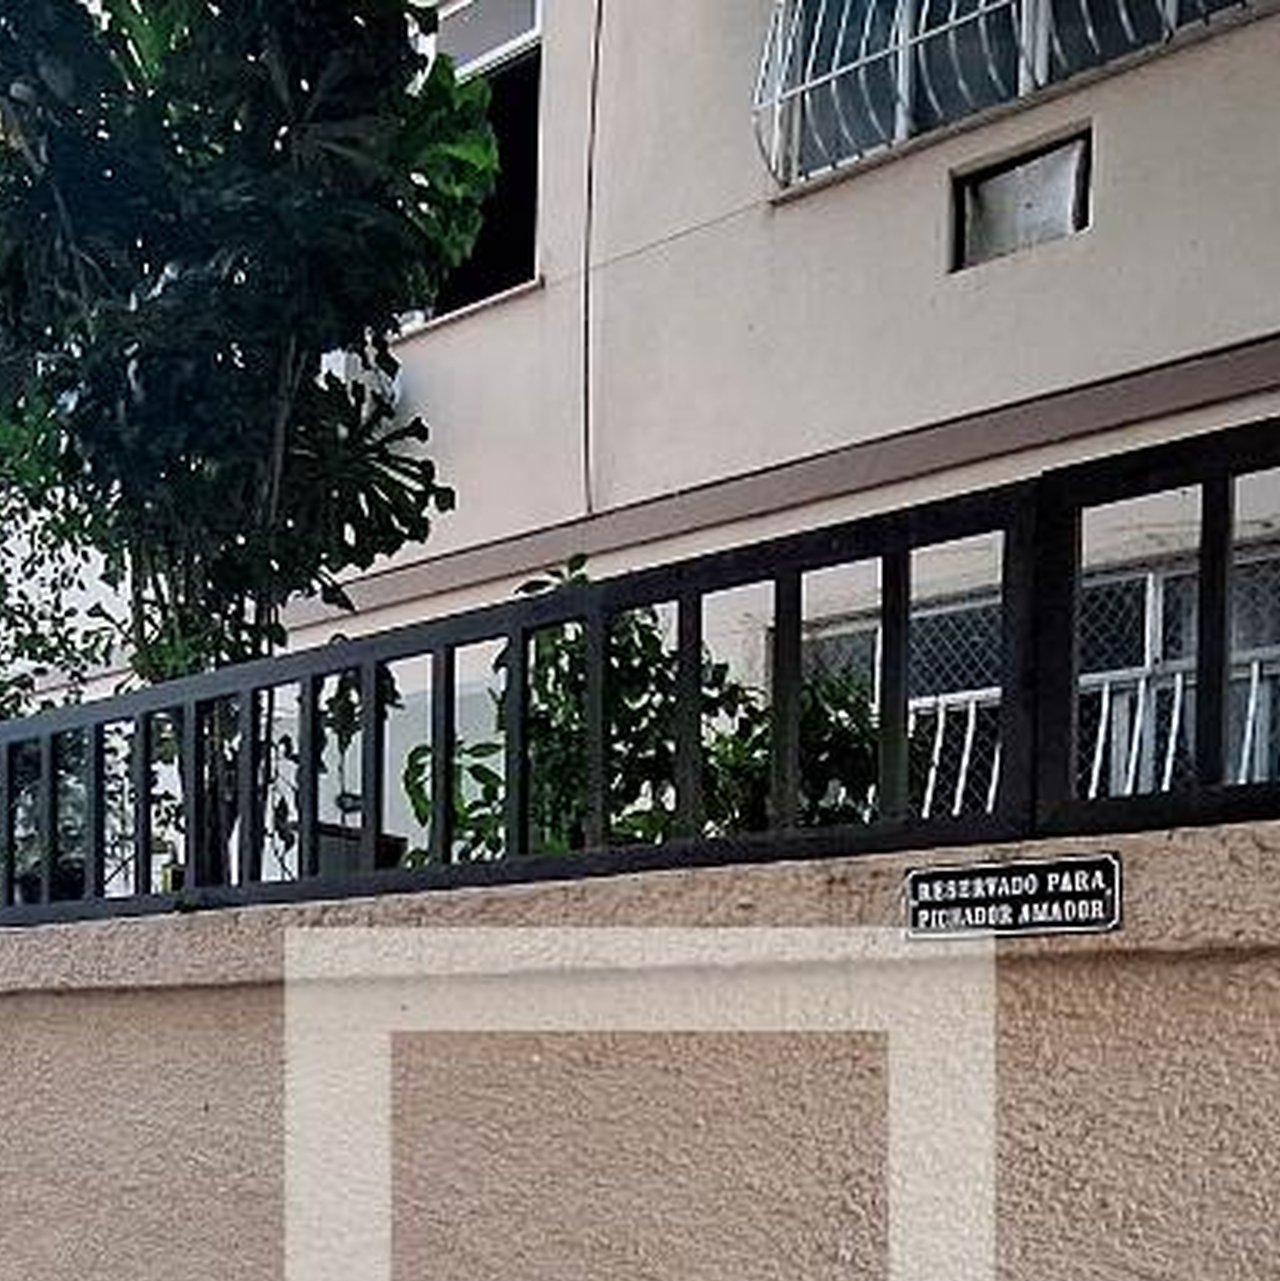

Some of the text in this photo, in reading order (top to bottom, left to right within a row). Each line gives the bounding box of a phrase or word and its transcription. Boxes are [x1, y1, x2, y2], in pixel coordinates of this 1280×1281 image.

[918, 869, 1107, 902] RESERVADO PARA
[1018, 899, 1106, 922] AMADOR
